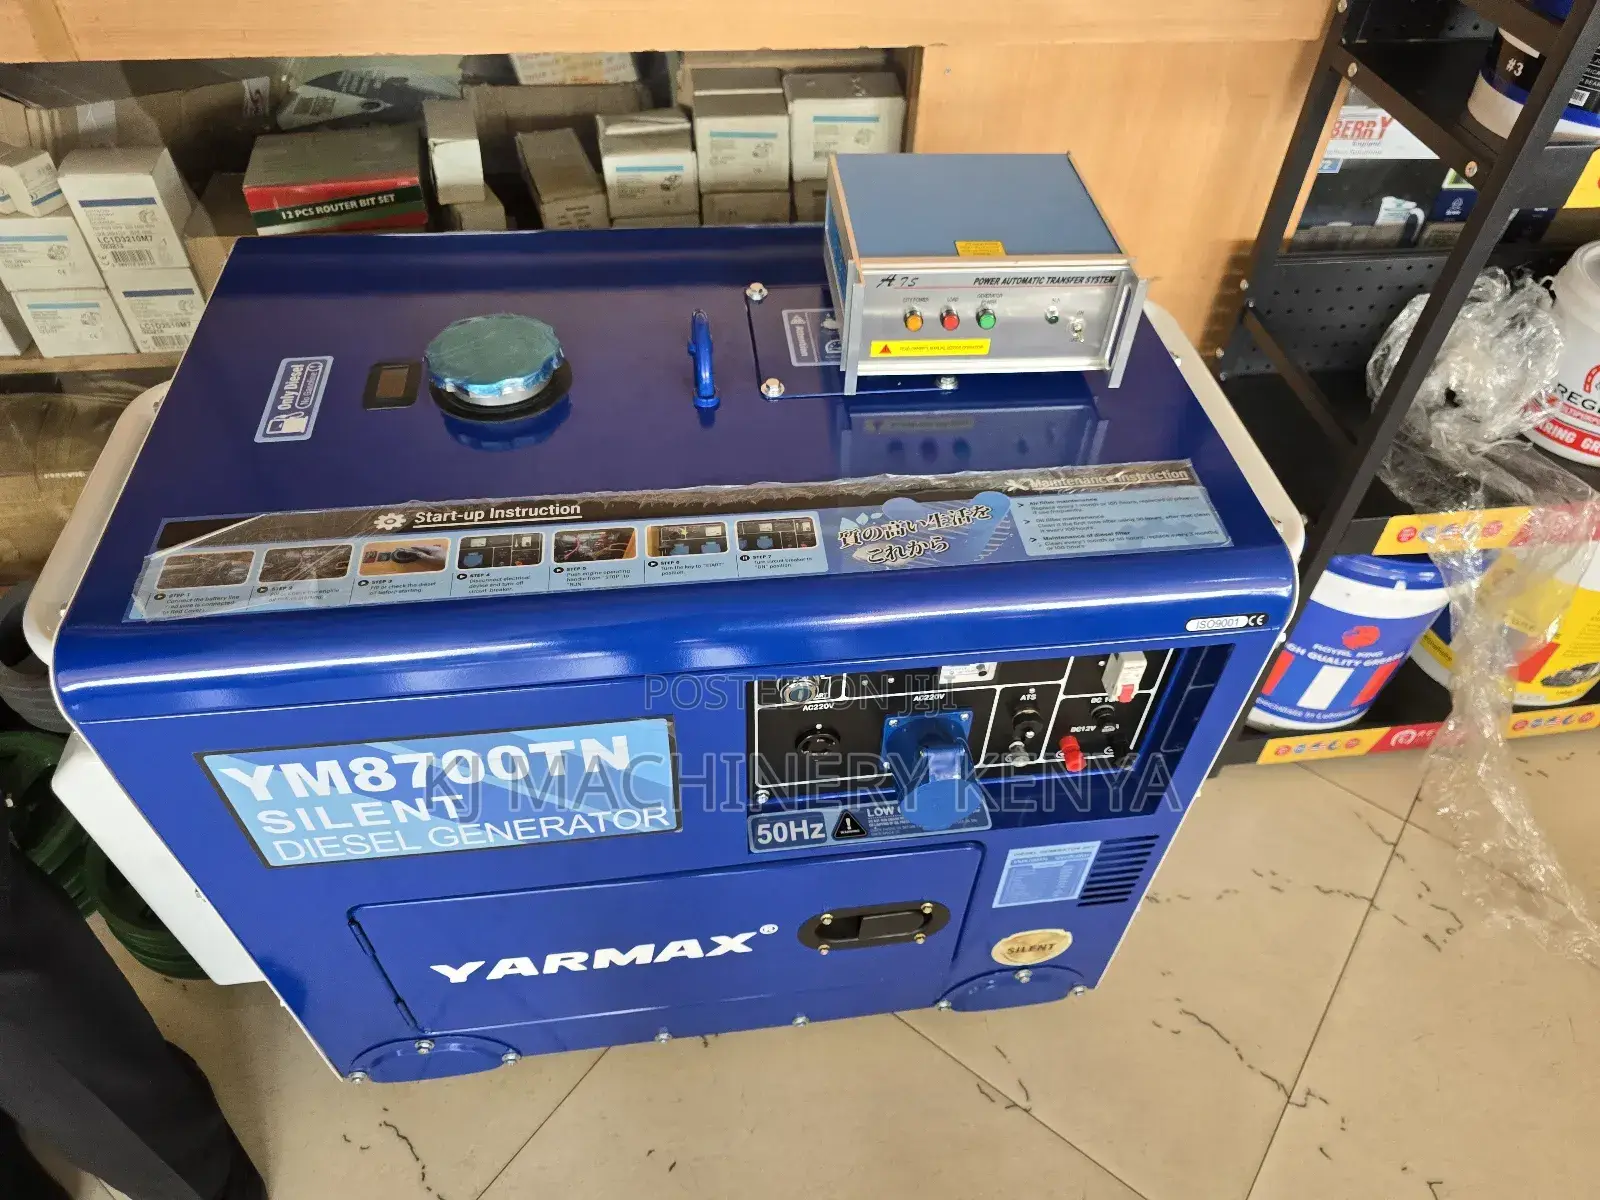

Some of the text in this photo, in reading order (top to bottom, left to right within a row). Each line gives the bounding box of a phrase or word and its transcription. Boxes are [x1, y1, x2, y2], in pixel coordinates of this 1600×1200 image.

[1505, 58, 1525, 77] #3
[281, 193, 396, 220] 12 PCS ROUTER BIT SET
[973, 275, 1116, 286] POWER AUTOMATIC TRANSFER SYSTEM
[278, 363, 305, 411] Only Diesel
[1580, 437, 1600, 453] GR
[1028, 469, 1189, 488] Maintenance Instruction
[414, 504, 581, 524] Start-up Instruction
[867, 536, 950, 564] これから
[1195, 618, 1240, 630] ISO9001
[1312, 643, 1352, 658] ROYAL
[1307, 652, 1362, 668] QUALITY
[913, 693, 945, 702] AC220V
[1020, 693, 1037, 701] ATS
[802, 702, 836, 712] AC220V
[1070, 725, 1096, 733] DC12V
[217, 734, 631, 801] YM8700TN
[256, 794, 465, 835] SILENT
[866, 806, 895, 817] LOW
[272, 806, 671, 862] DIESEL GENERATOR
[757, 820, 826, 844] 50Hz
[429, 931, 758, 984] YARMAX
[1007, 943, 1056, 955] SILENT
